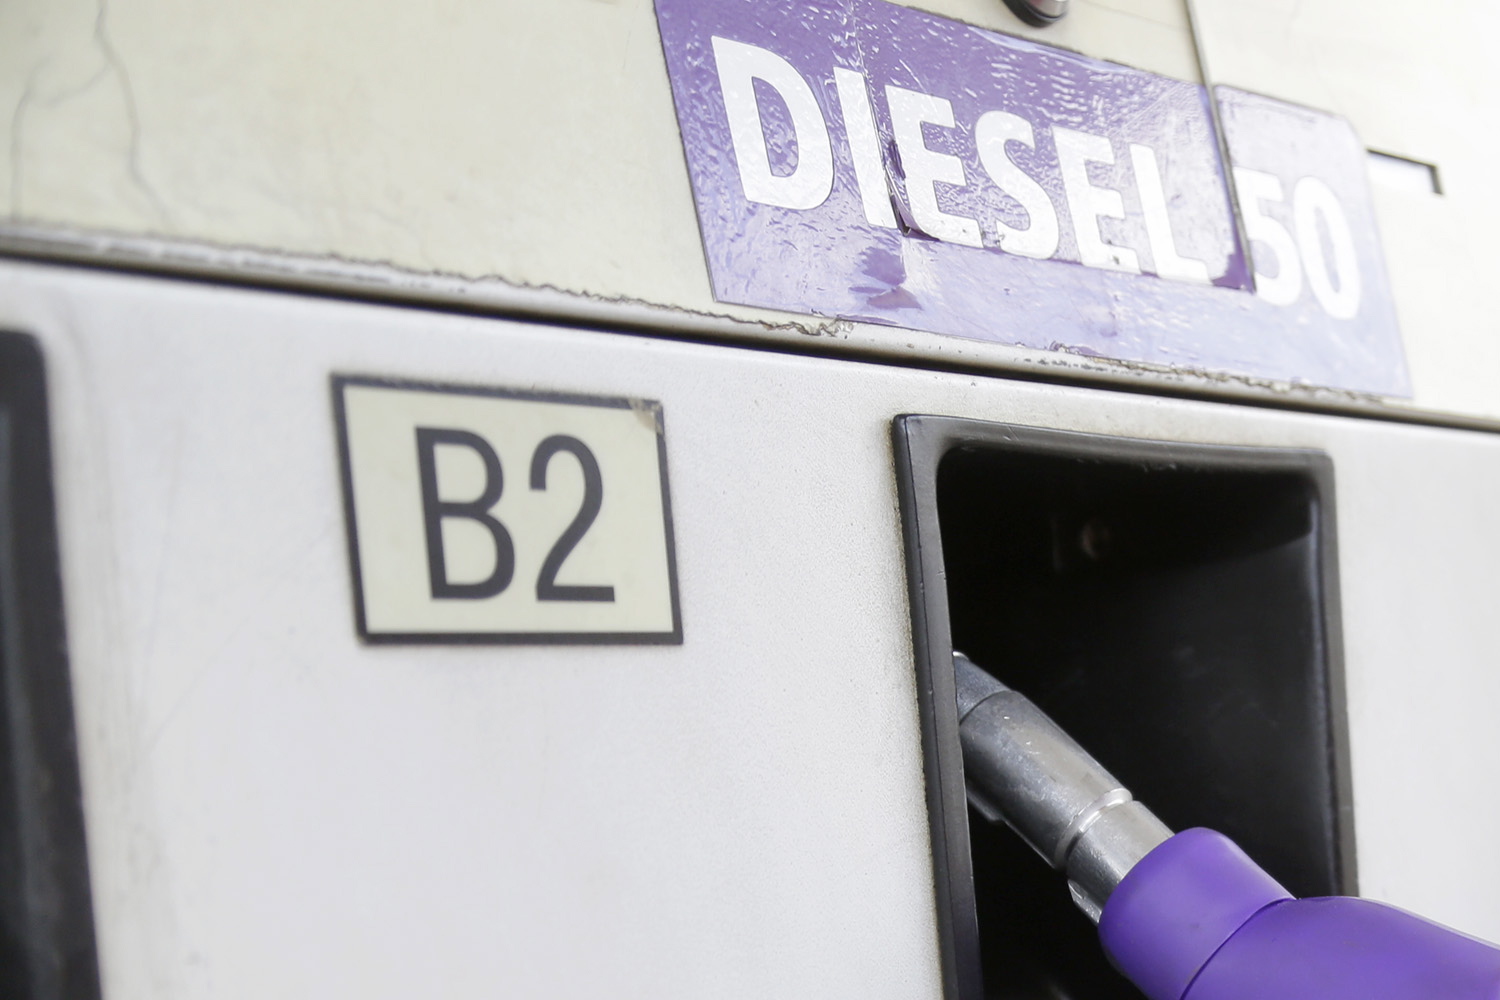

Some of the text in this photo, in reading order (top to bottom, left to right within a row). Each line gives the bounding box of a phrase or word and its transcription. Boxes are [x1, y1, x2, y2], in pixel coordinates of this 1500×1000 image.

[711, 35, 1362, 321] DIESEL 50
[415, 426, 616, 603] B2
